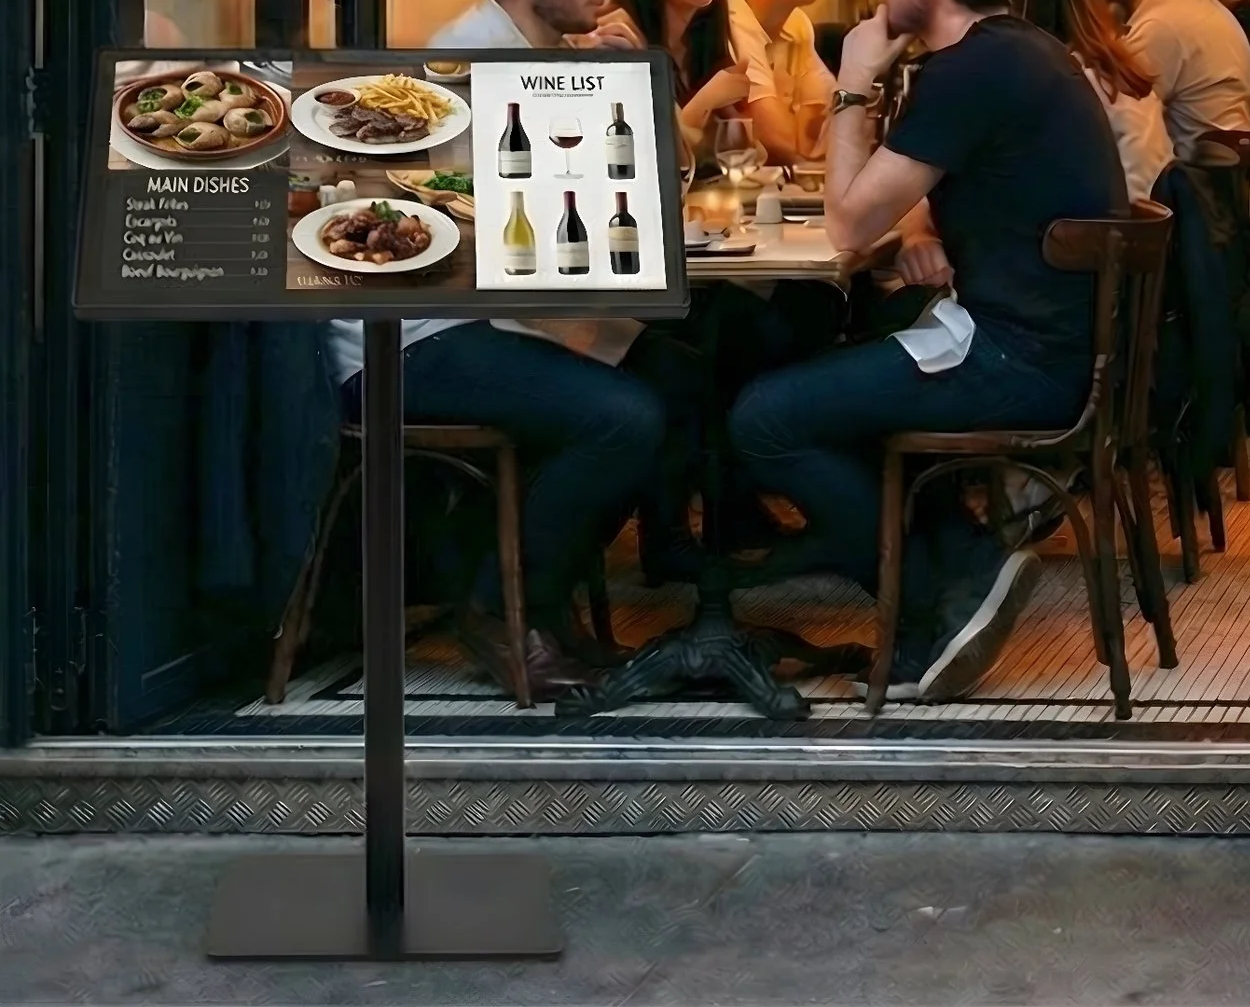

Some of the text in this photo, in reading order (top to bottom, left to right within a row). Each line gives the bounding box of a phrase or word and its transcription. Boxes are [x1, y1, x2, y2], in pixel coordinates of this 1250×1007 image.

[520, 76, 605, 91] WINE LIST
[147, 176, 250, 193] MAIN DISHES
